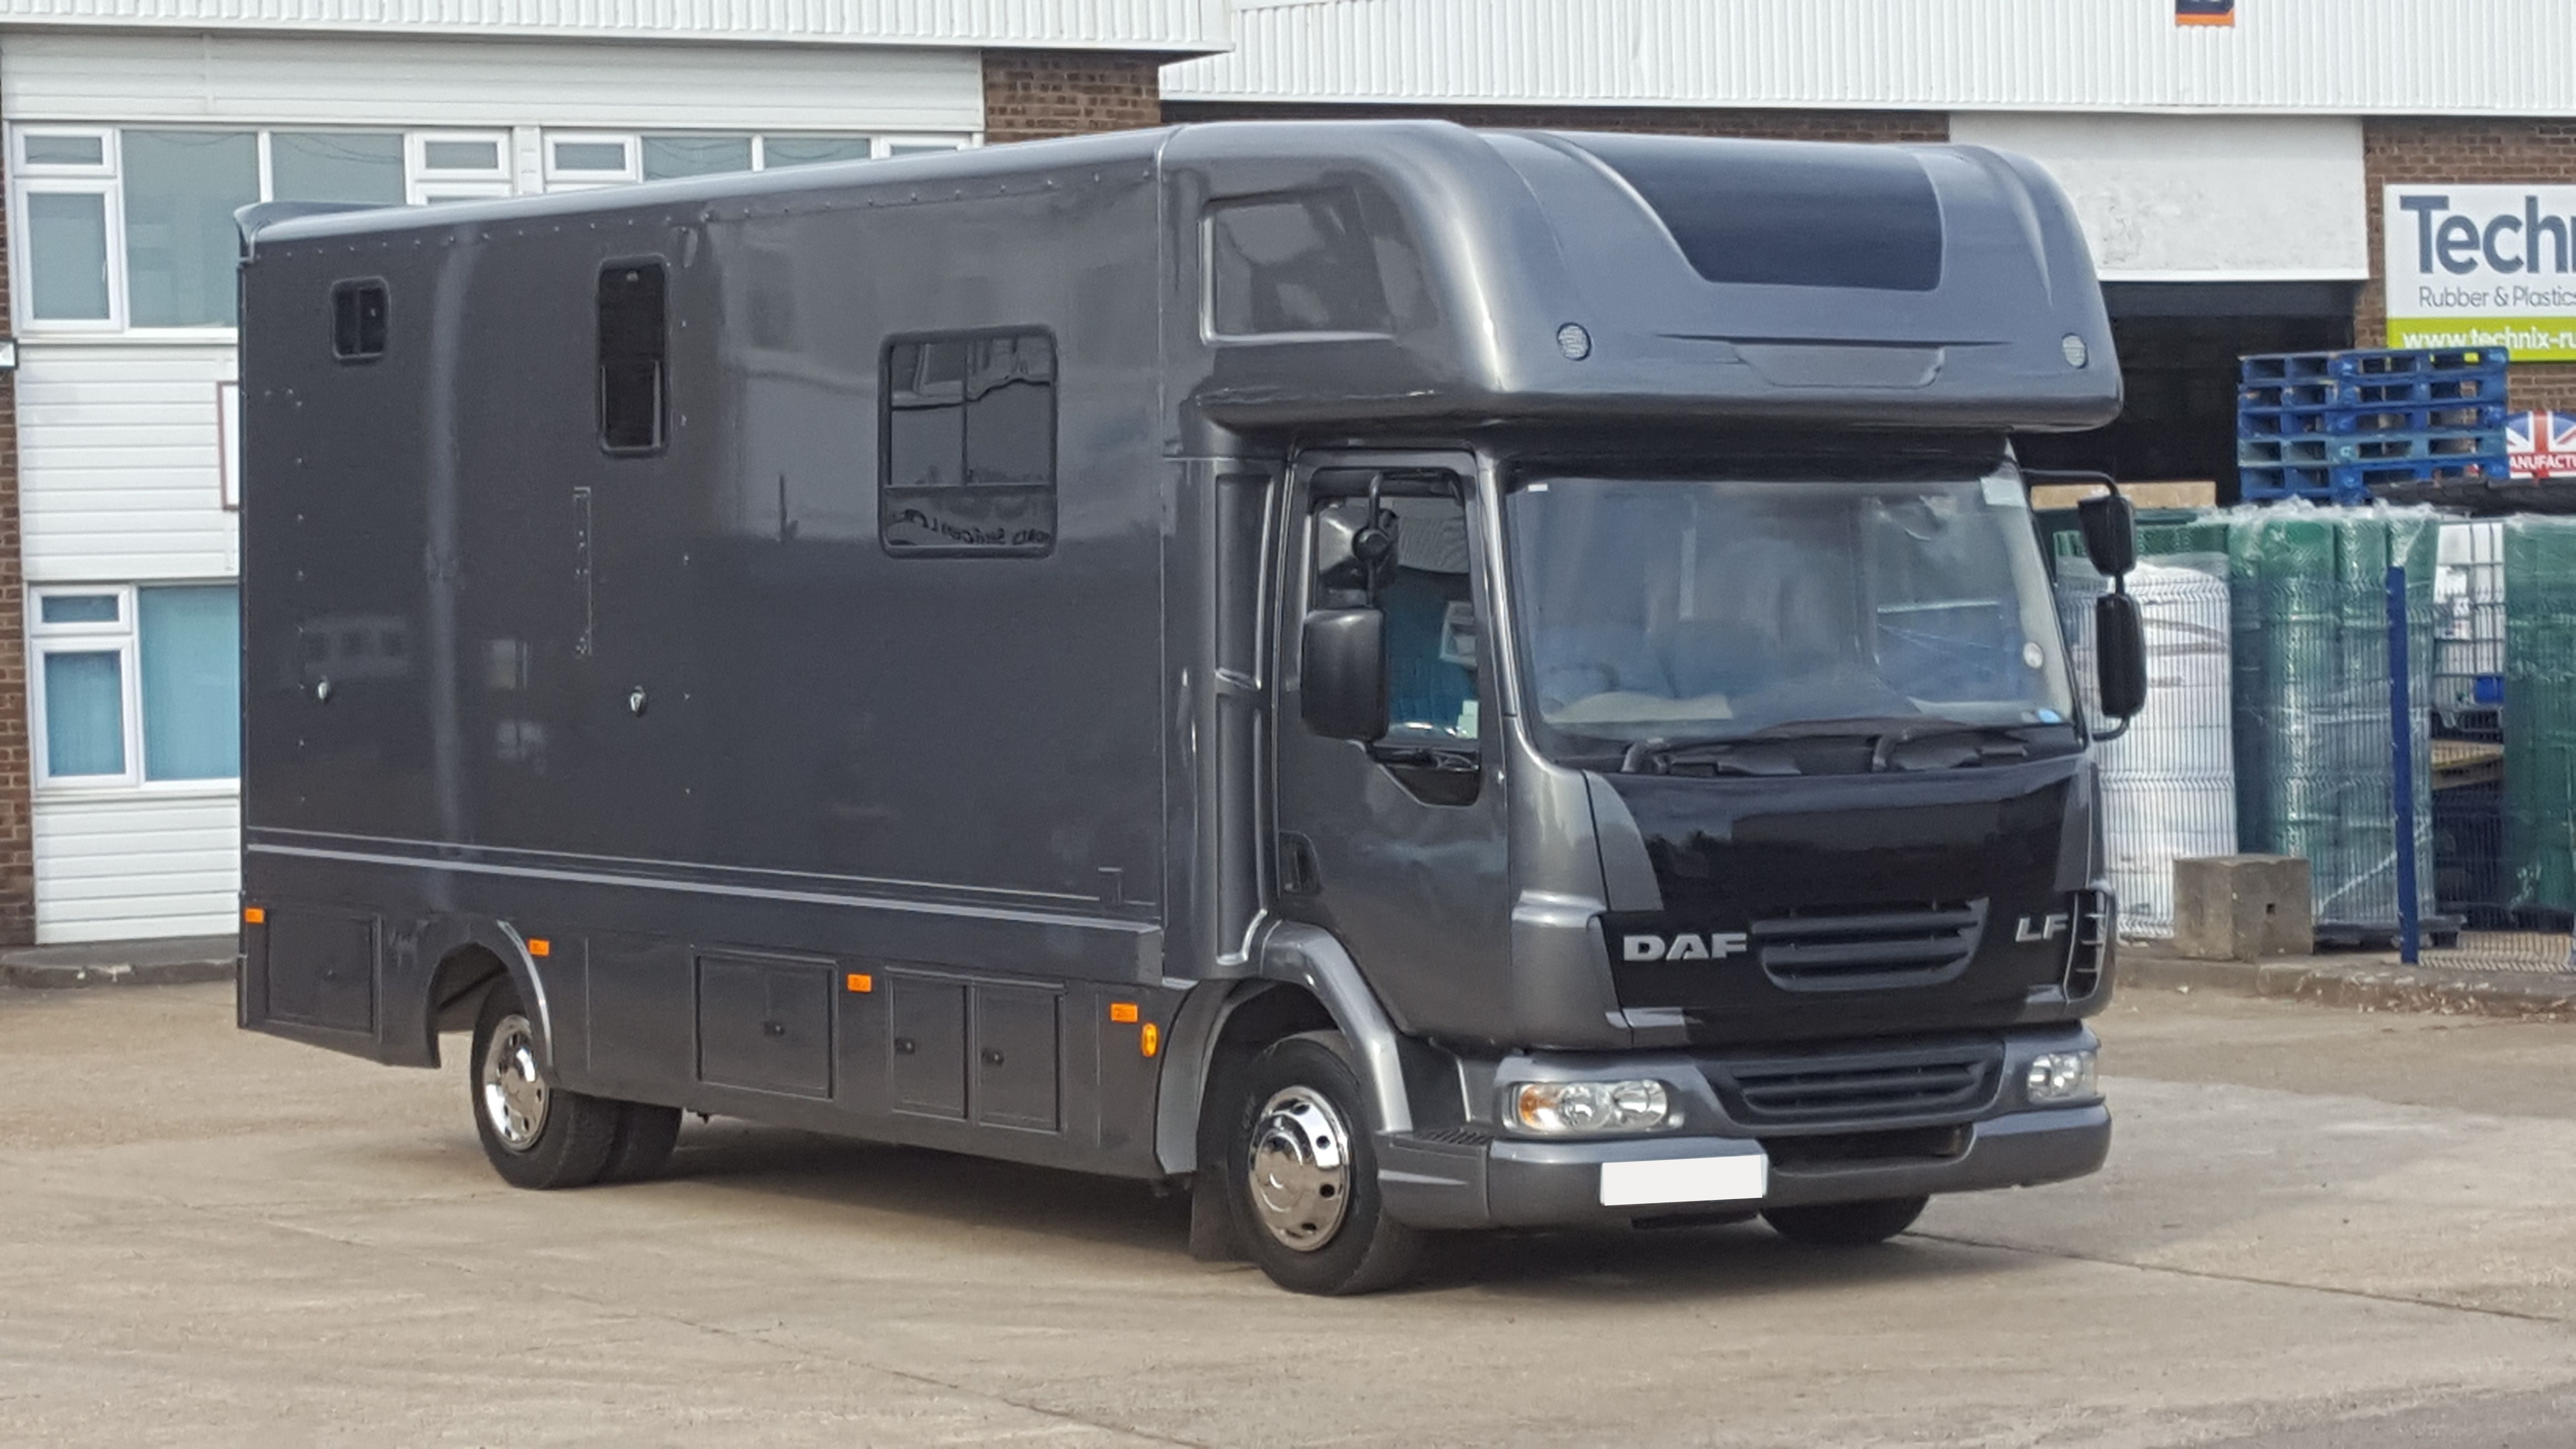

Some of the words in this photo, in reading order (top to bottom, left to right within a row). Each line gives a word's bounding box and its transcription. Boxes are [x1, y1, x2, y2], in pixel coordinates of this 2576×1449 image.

[2399, 195, 2576, 275] Tech
[2418, 286, 2490, 307] Rubber
[2494, 285, 2509, 307] &
[2015, 914, 2069, 942] LF
[1623, 933, 1747, 961] DAF
